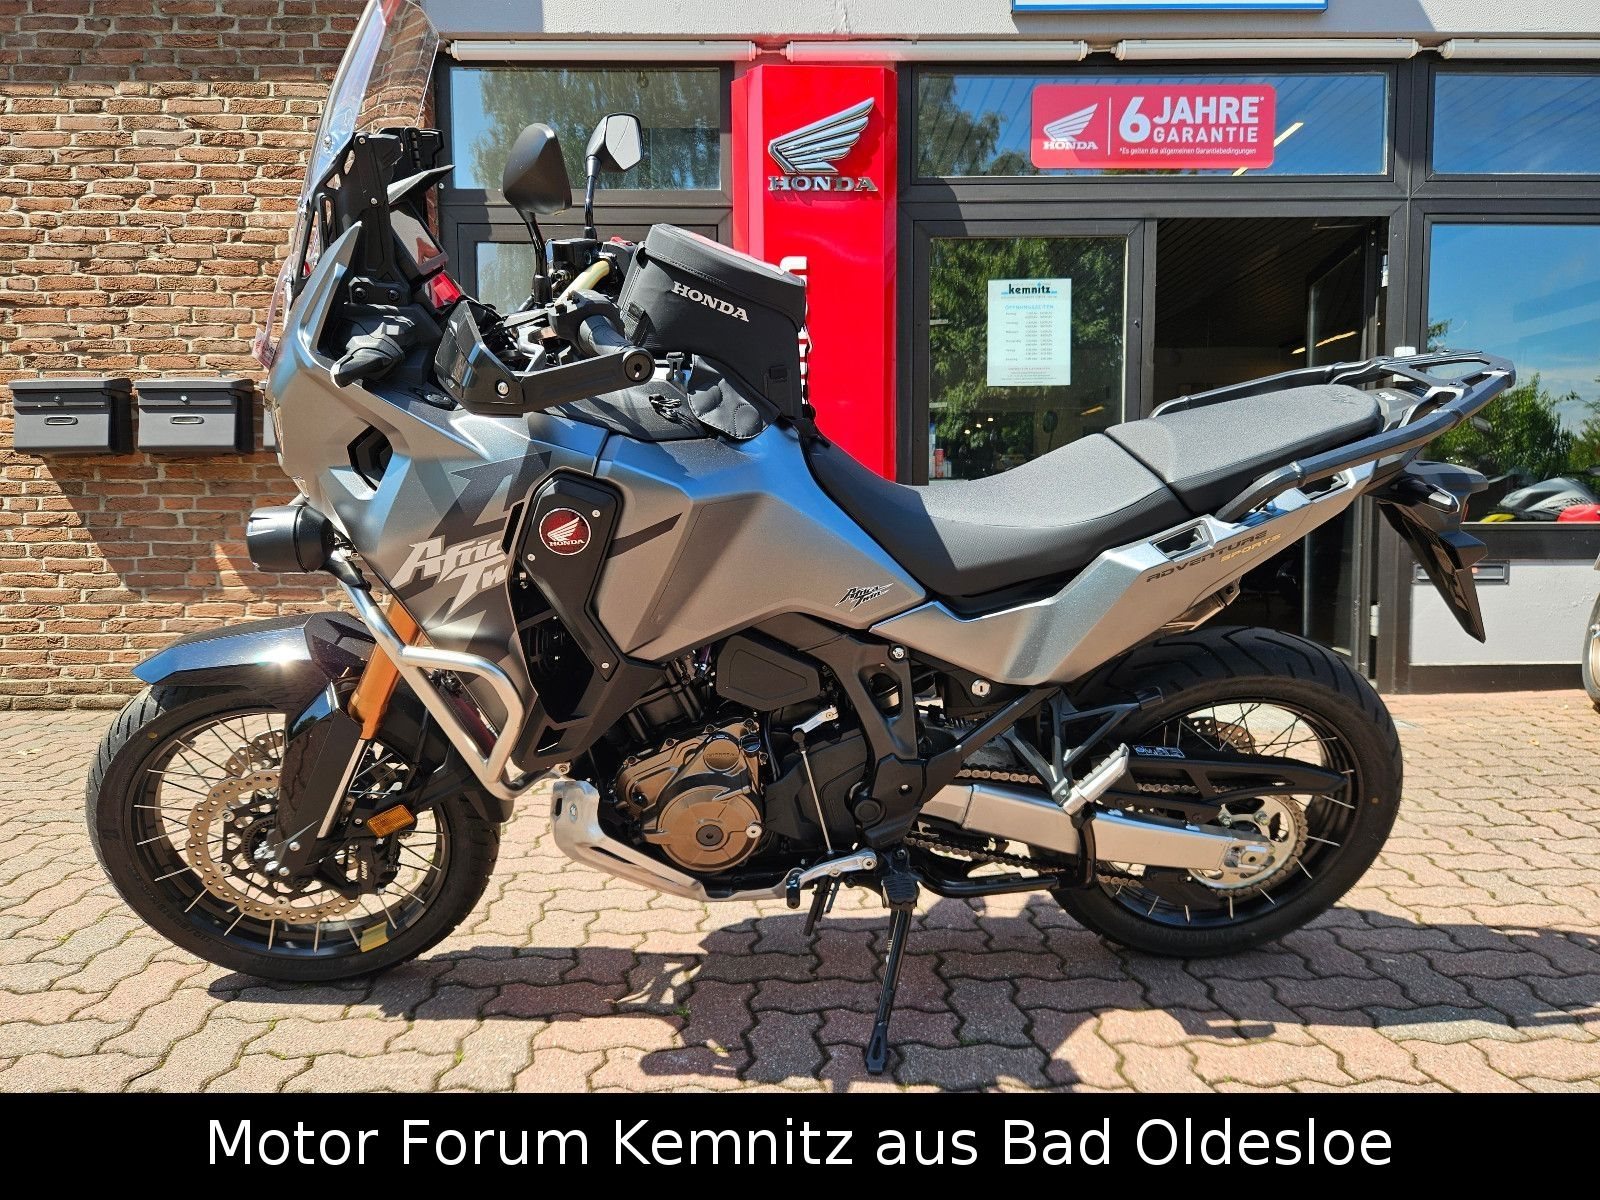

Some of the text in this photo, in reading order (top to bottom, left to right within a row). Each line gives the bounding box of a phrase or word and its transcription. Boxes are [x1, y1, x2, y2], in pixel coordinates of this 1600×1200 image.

[1118, 96, 1150, 143] 6
[1153, 127, 1258, 143] GARANTIE
[1042, 139, 1099, 150] HONDA
[768, 176, 878, 192] HONDA
[1008, 283, 1051, 294] kemnitz
[671, 280, 750, 323] HONDA
[548, 539, 586, 547] HONDA
[1220, 532, 1281, 563] SPORTS
[1146, 529, 1268, 583] ADVENTURE
